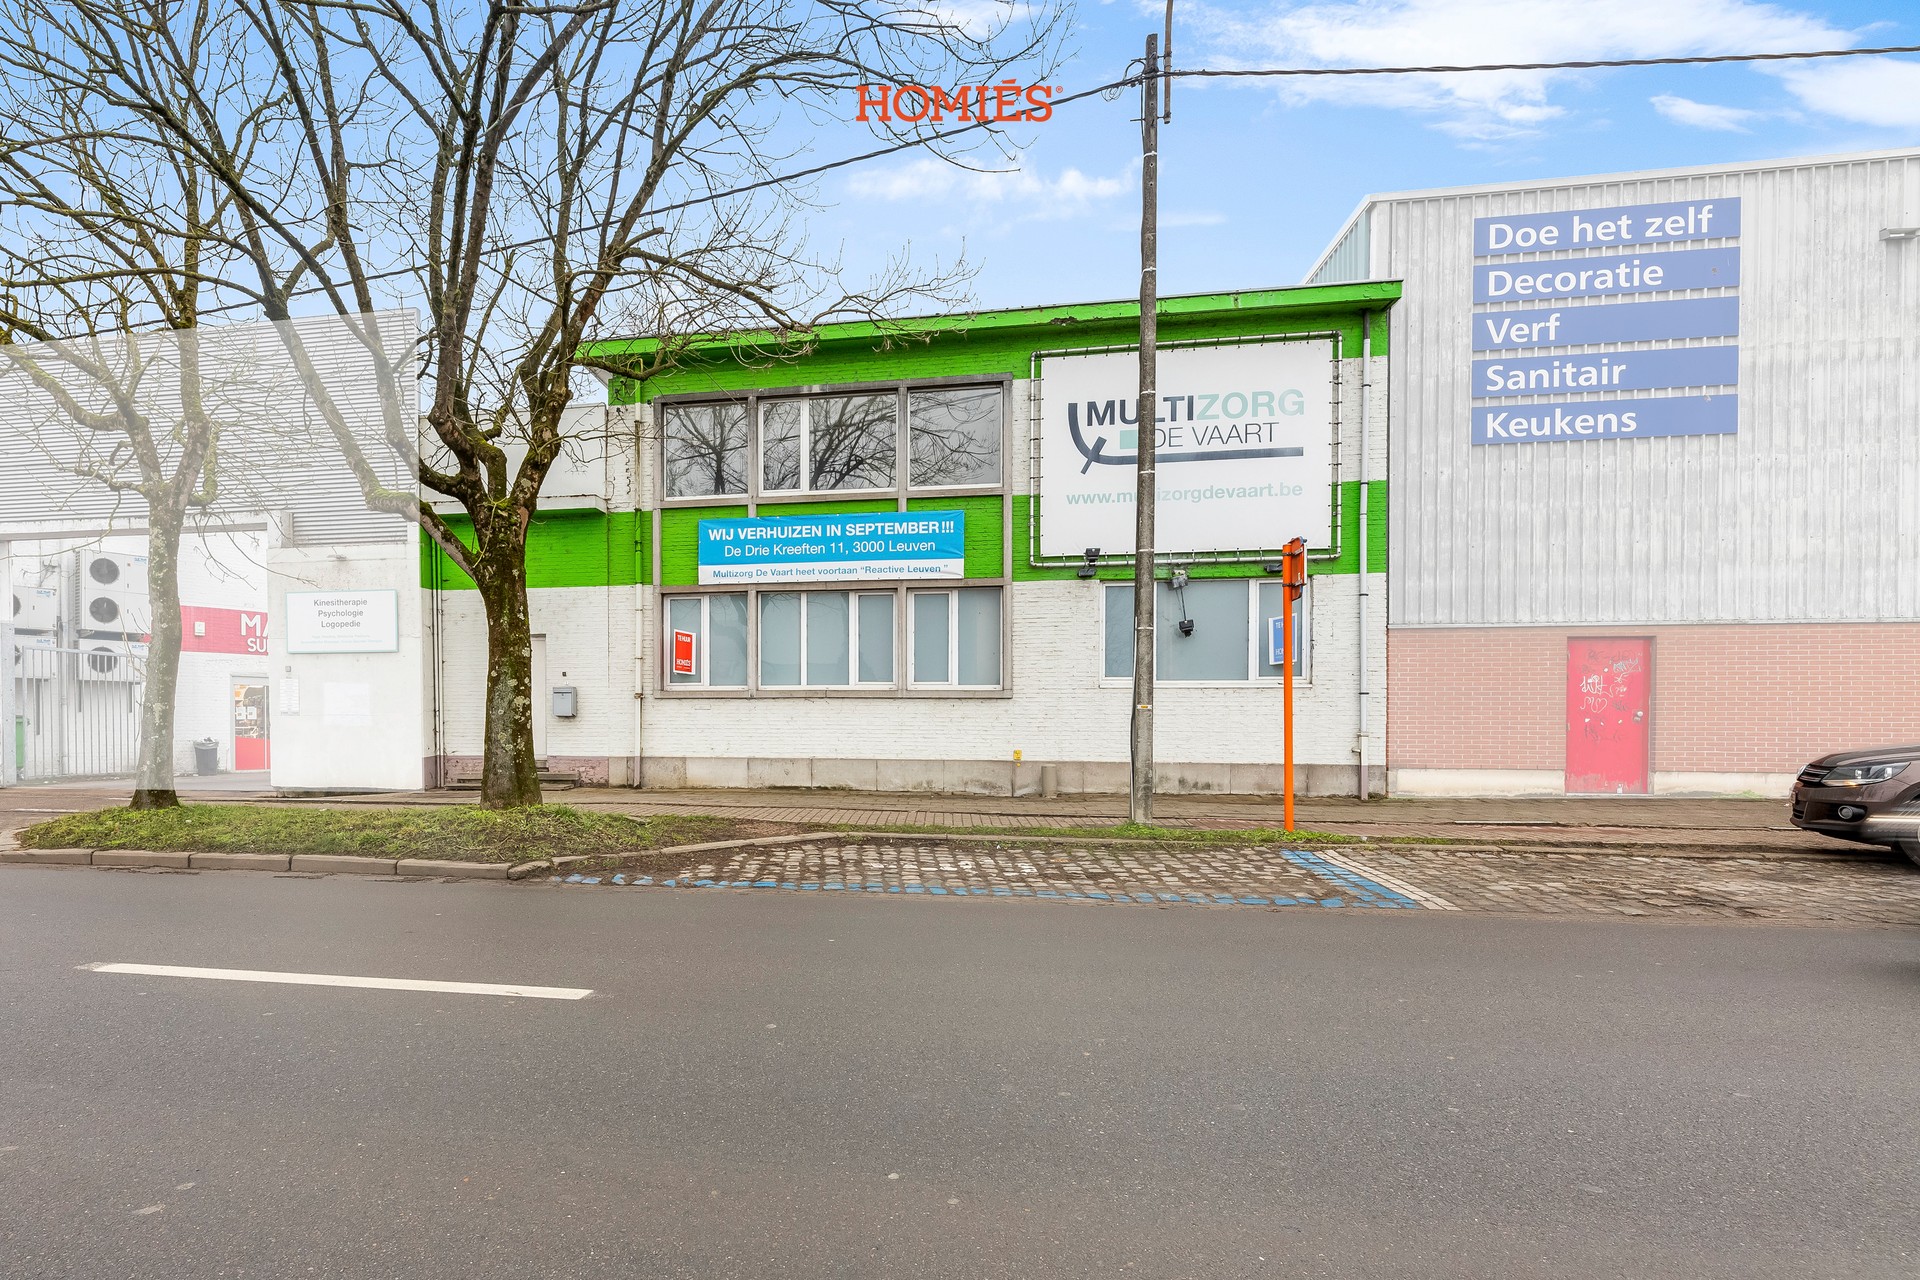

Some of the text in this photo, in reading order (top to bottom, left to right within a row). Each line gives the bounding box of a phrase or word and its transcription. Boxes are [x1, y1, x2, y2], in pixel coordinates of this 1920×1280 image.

[1488, 204, 1714, 250] Doe het zelf
[1488, 259, 1664, 297] Decoratie
[1486, 312, 1560, 344] Verf
[1486, 358, 1627, 392] Sanitair
[1191, 422, 1280, 447] VAART
[1486, 407, 1637, 439] Keukens
[1066, 482, 1303, 505] www.mizorgdevaart.be
[708, 520, 954, 541] WIJ VERHUIZEN IN SEPTEMBER!!!
[724, 539, 936, 558] De Drie Kreeften 11, 3000 Leuven
[712, 568, 754, 579] Multizorg
[756, 568, 768, 577] De
[769, 567, 793, 576] Vaart
[795, 566, 815, 575] heet
[817, 566, 858, 575] voortaan
[313, 597, 368, 607] Kinesitherapie
[317, 608, 364, 619] Psychologie
[321, 619, 361, 629] Logopedie
